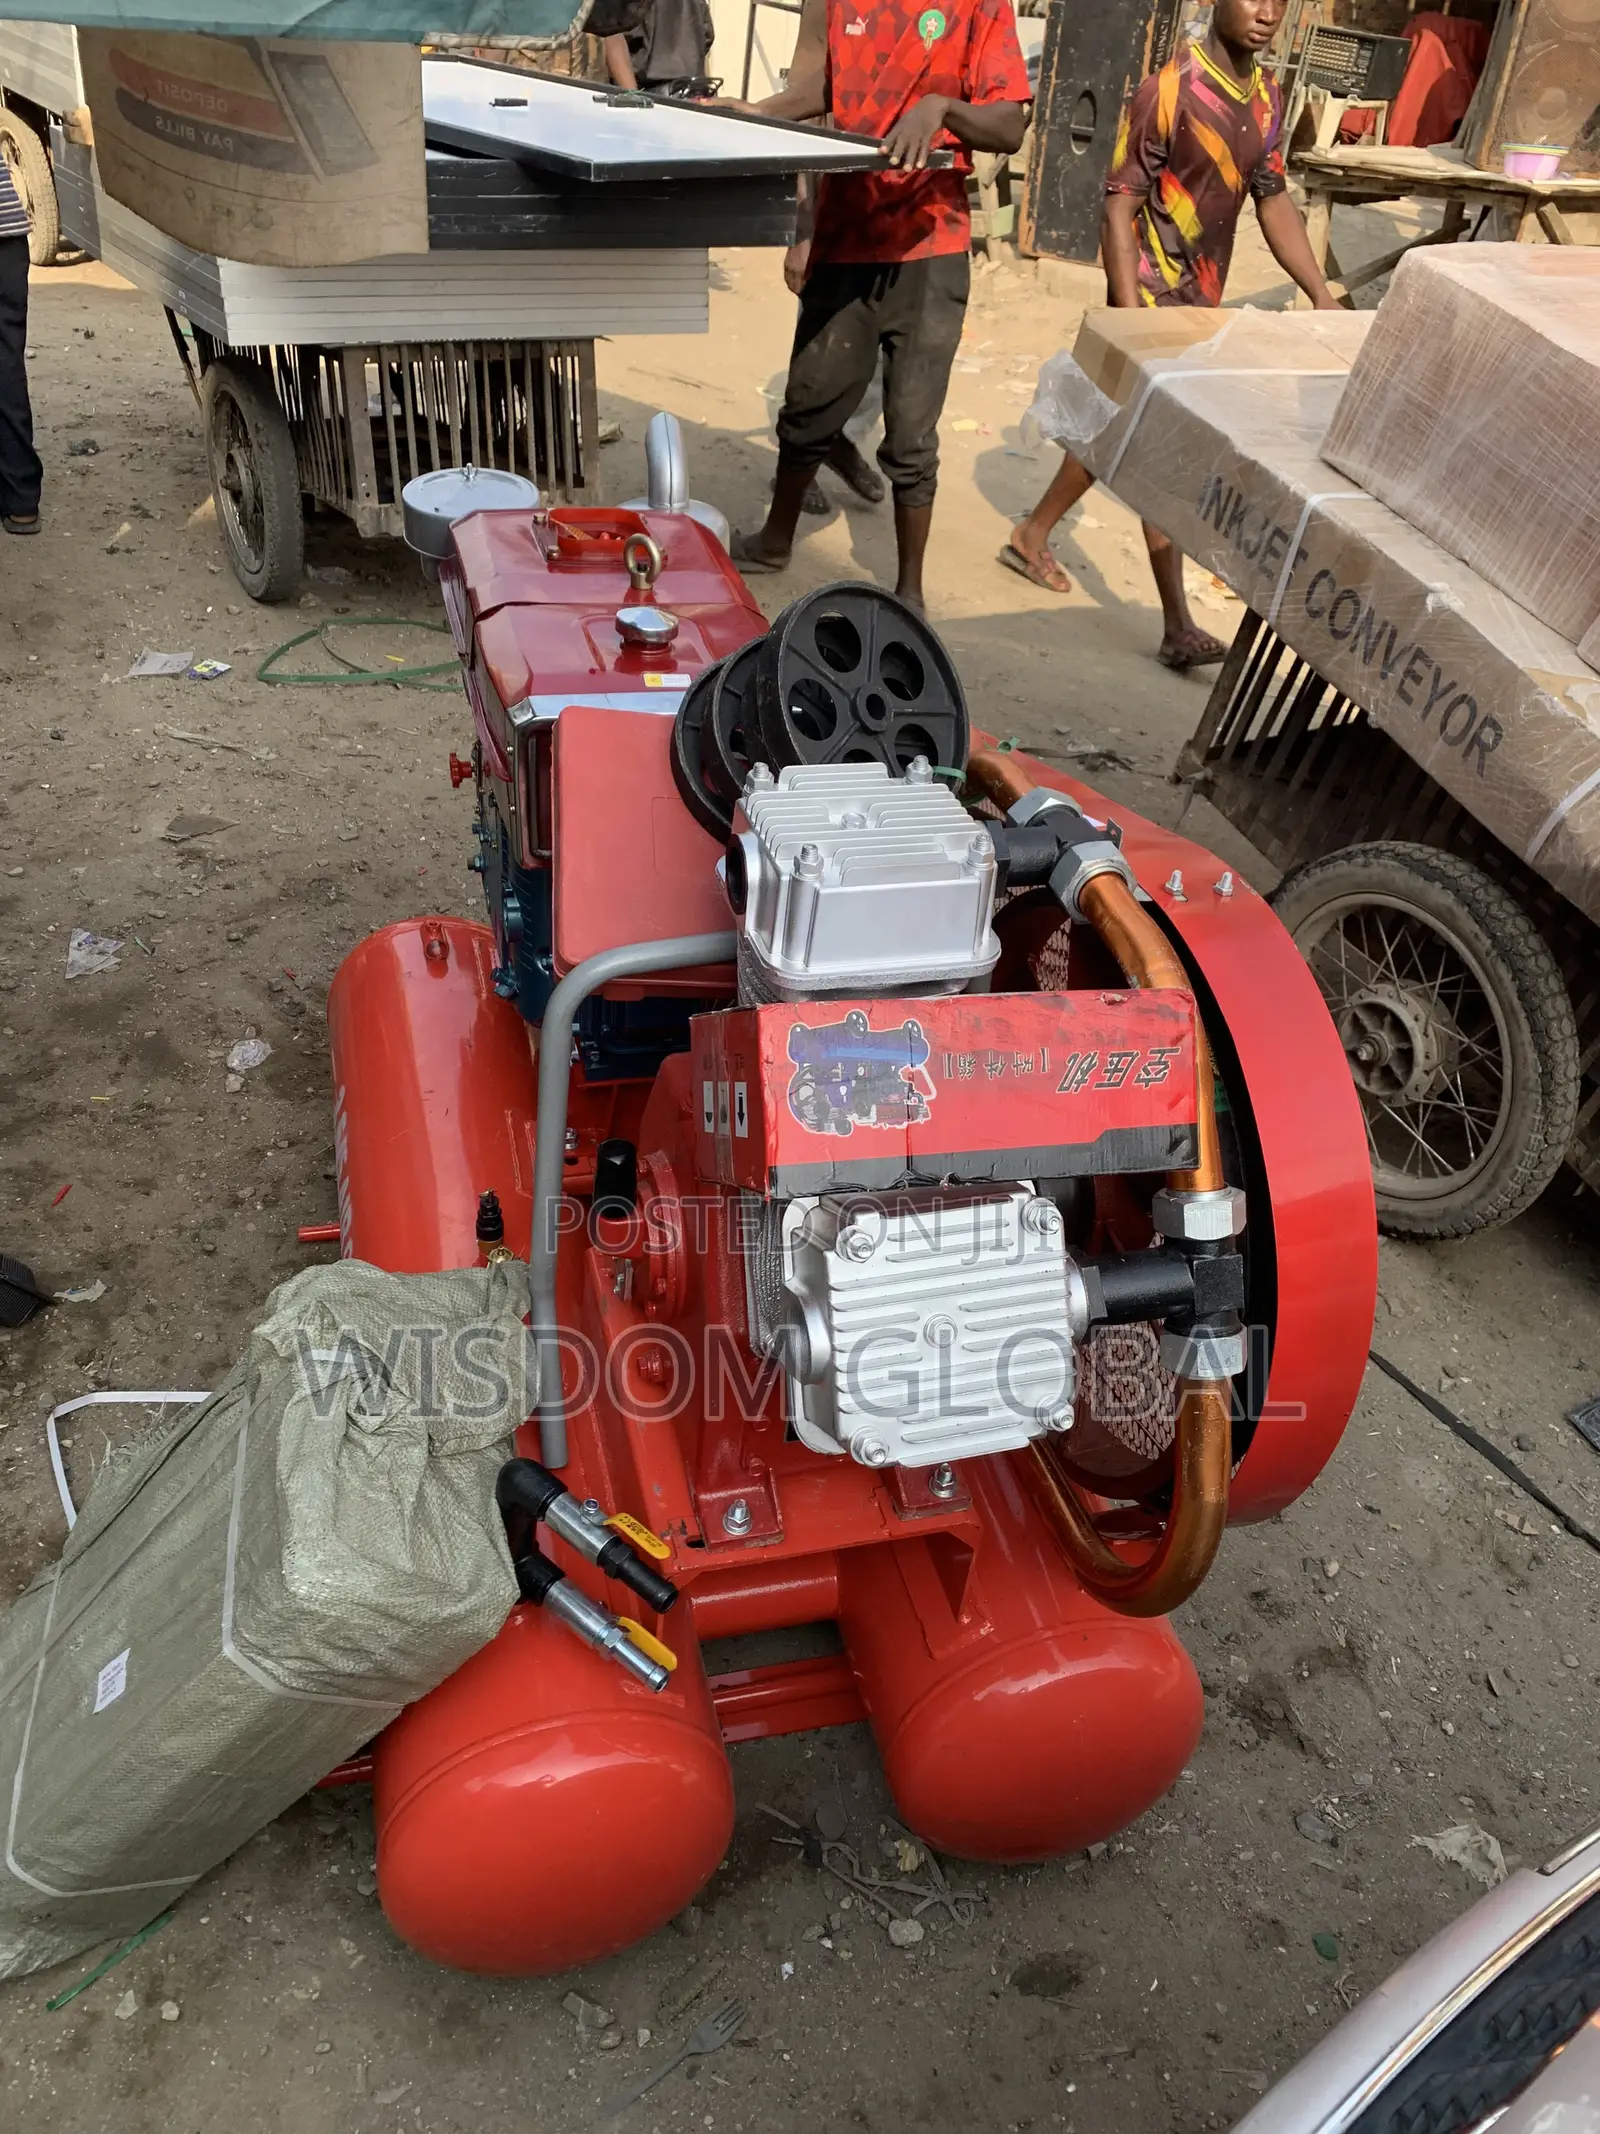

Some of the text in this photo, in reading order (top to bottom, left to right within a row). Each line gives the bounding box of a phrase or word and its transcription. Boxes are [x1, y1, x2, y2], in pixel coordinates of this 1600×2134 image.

[1304, 568, 1504, 779] CONVEYOR
[1056, 1047, 1182, 1094] 空压机
